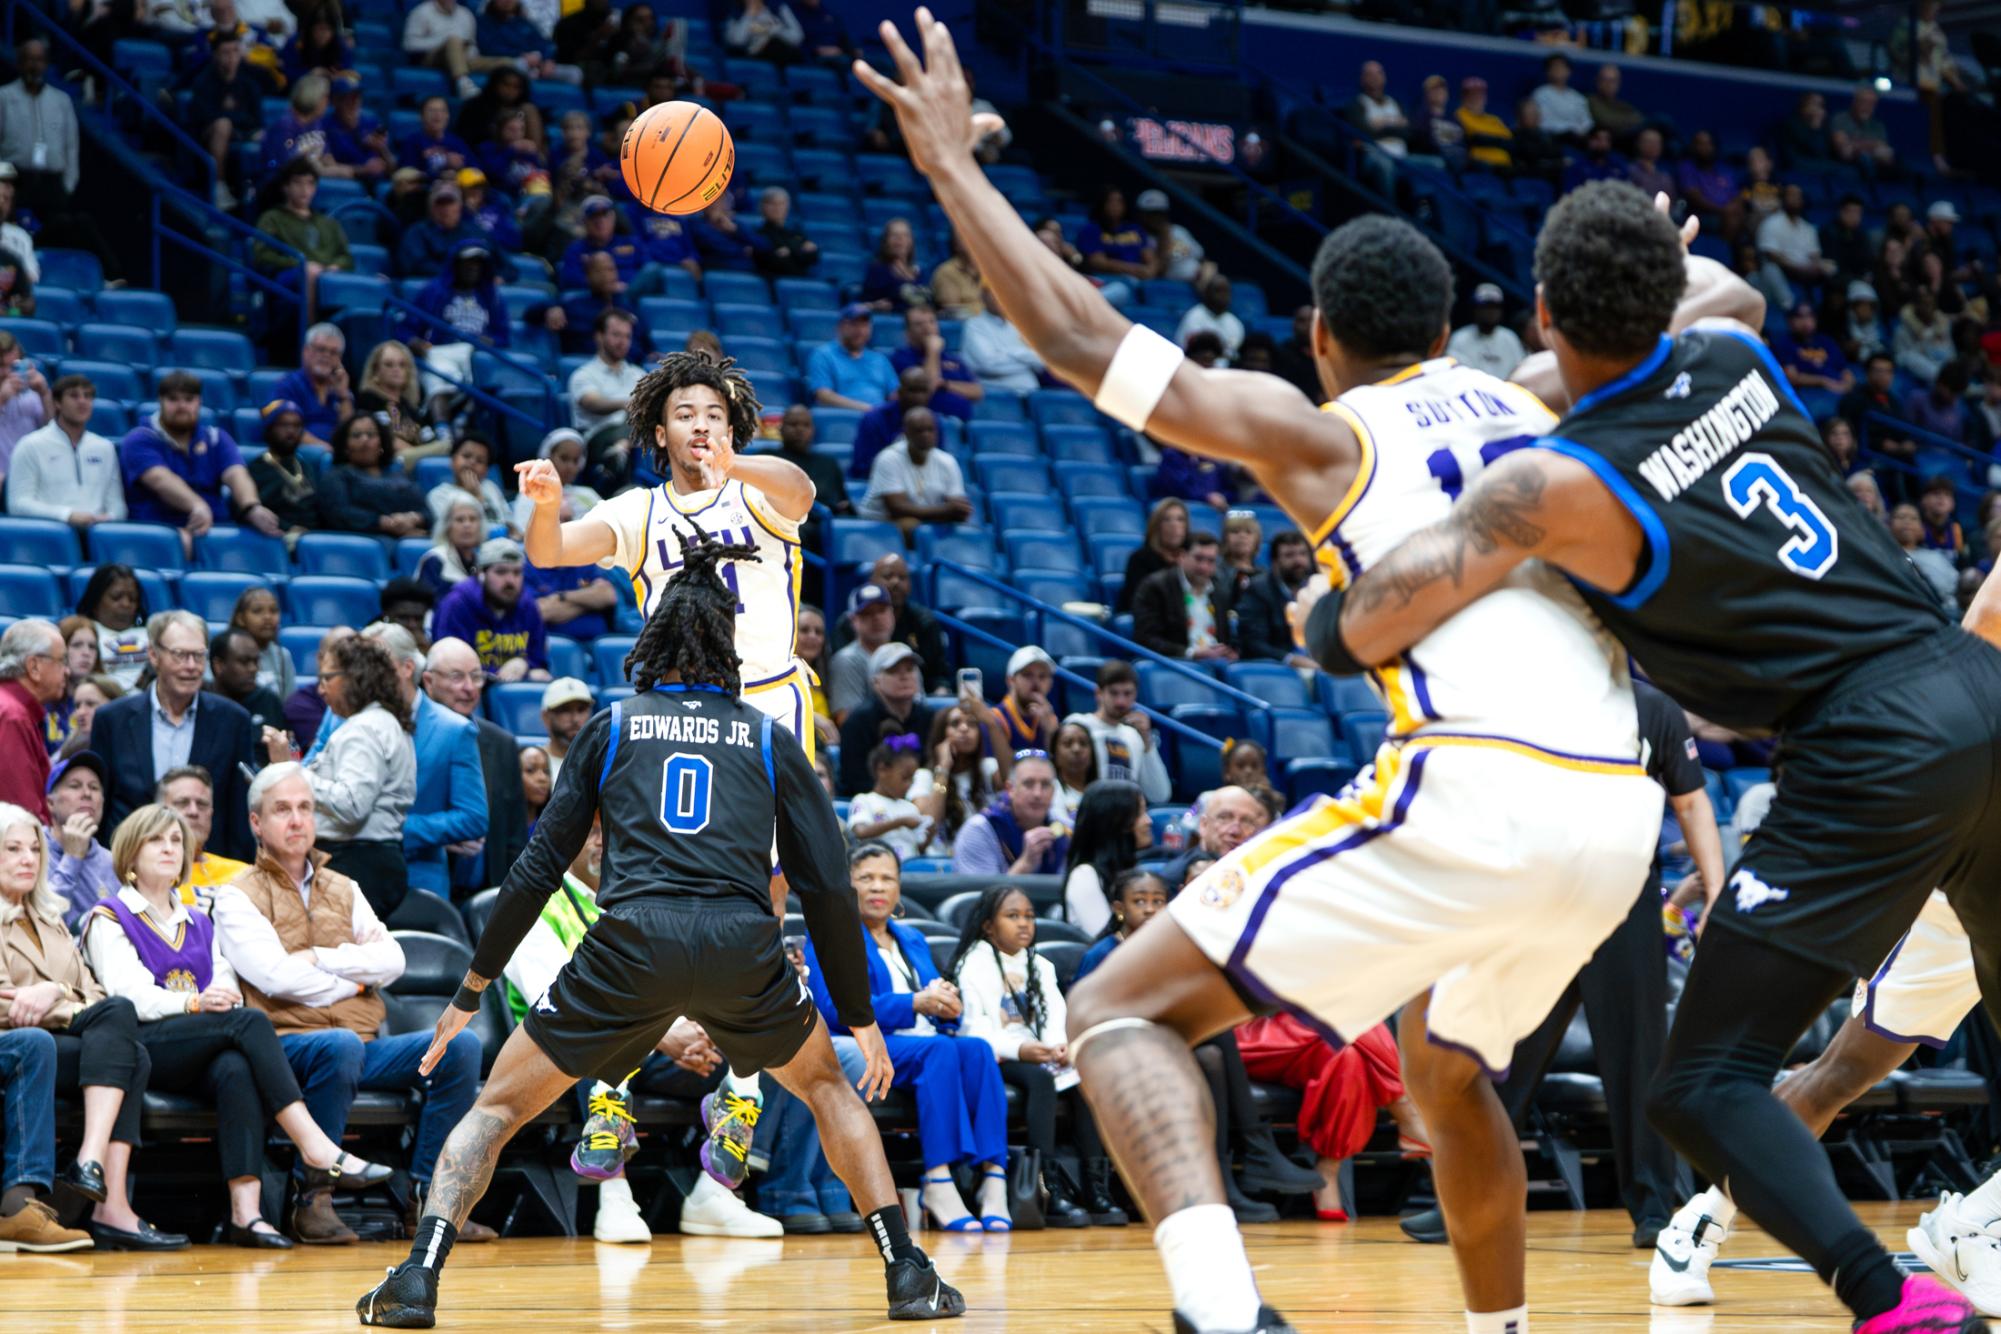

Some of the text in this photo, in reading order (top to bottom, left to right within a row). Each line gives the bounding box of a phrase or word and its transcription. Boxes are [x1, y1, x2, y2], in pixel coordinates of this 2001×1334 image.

[1405, 388, 1517, 428] SUTTON
[1638, 368, 1780, 503] WASHINGTON
[1721, 452, 1838, 581] 3
[629, 715, 754, 748] EDWARDS JR.
[659, 752, 714, 834] 0
